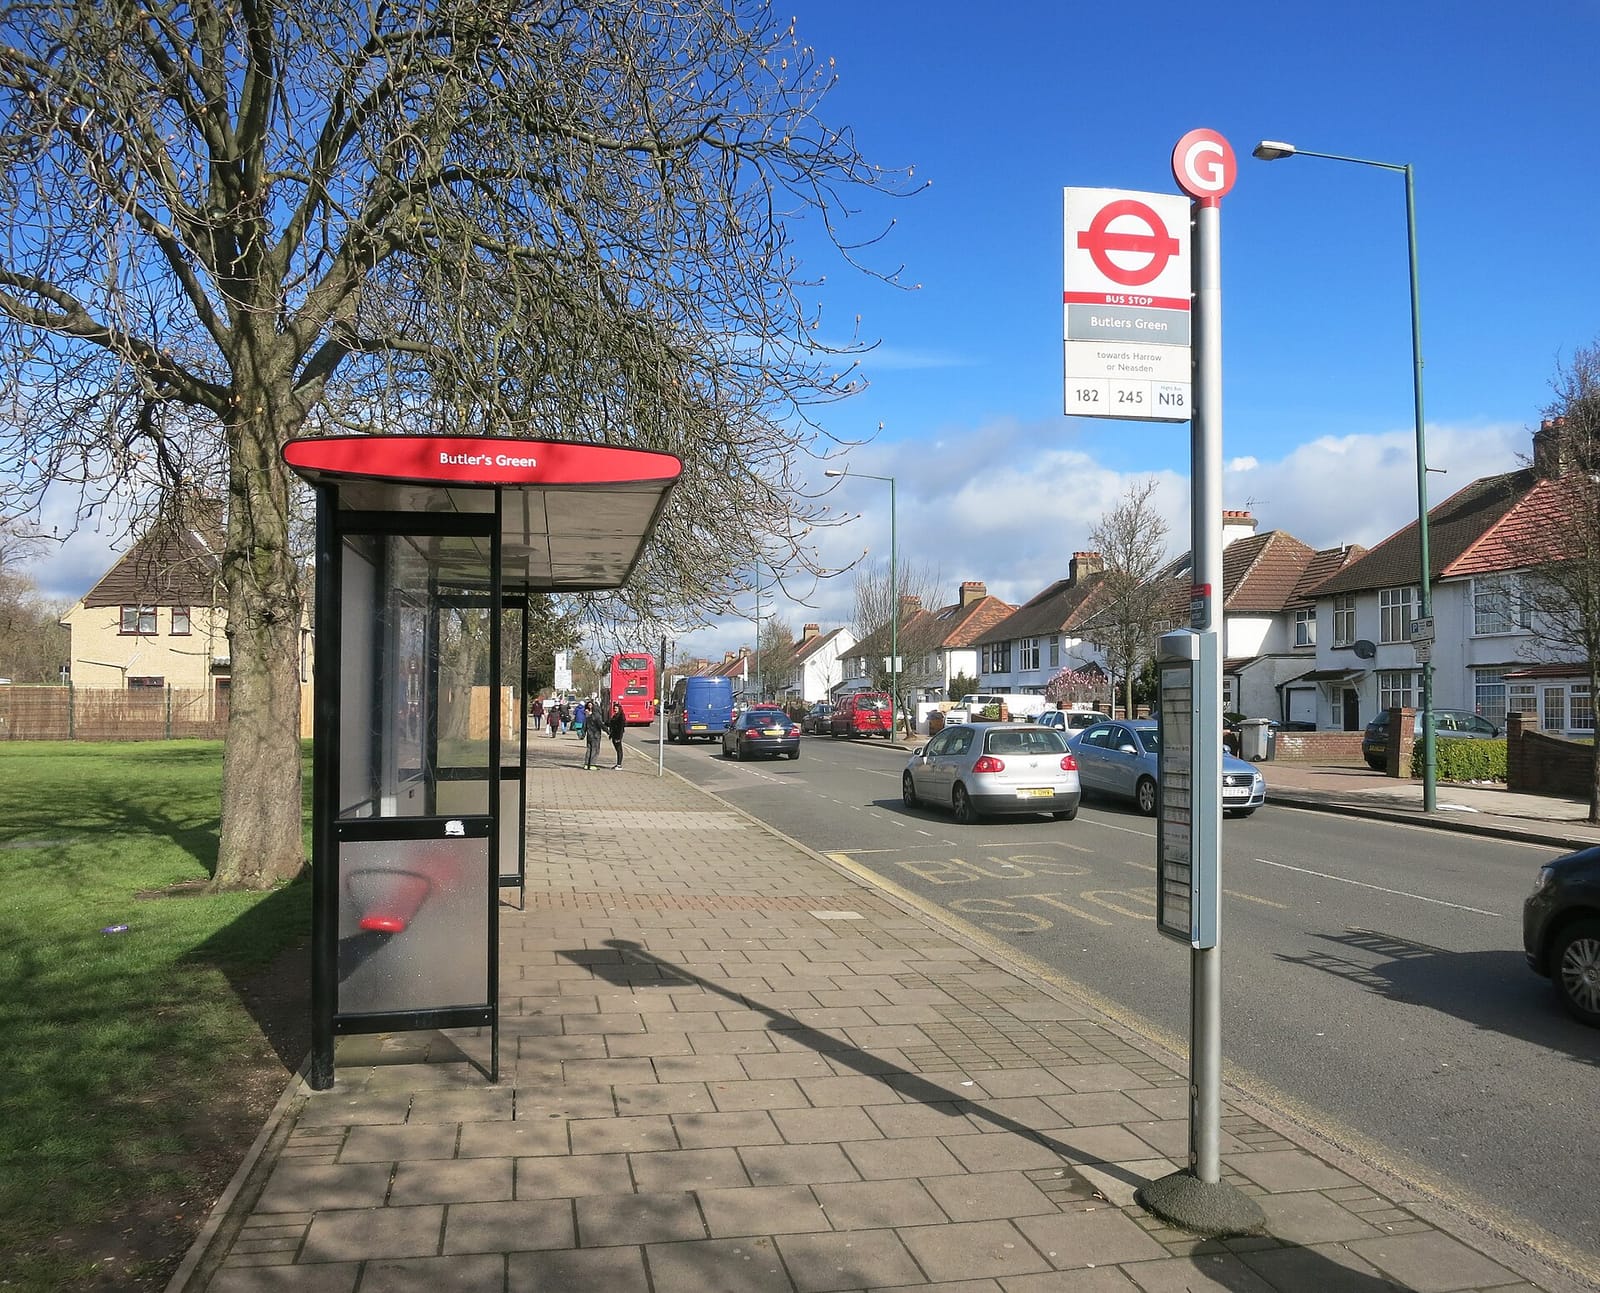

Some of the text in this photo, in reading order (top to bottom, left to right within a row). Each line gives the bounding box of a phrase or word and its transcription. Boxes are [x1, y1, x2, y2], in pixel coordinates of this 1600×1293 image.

[1185, 140, 1225, 191] G
[1105, 295, 1153, 305] BUS STOP
[1090, 316, 1168, 331] Butlers Green
[1097, 351, 1162, 361] towards Harrow
[1118, 363, 1153, 373] Neasden
[1076, 389, 1099, 402] 182
[1118, 390, 1143, 403] 245
[1159, 393, 1184, 406] N18
[440, 453, 536, 467] Butler's Green
[895, 855, 1093, 885] BUS
